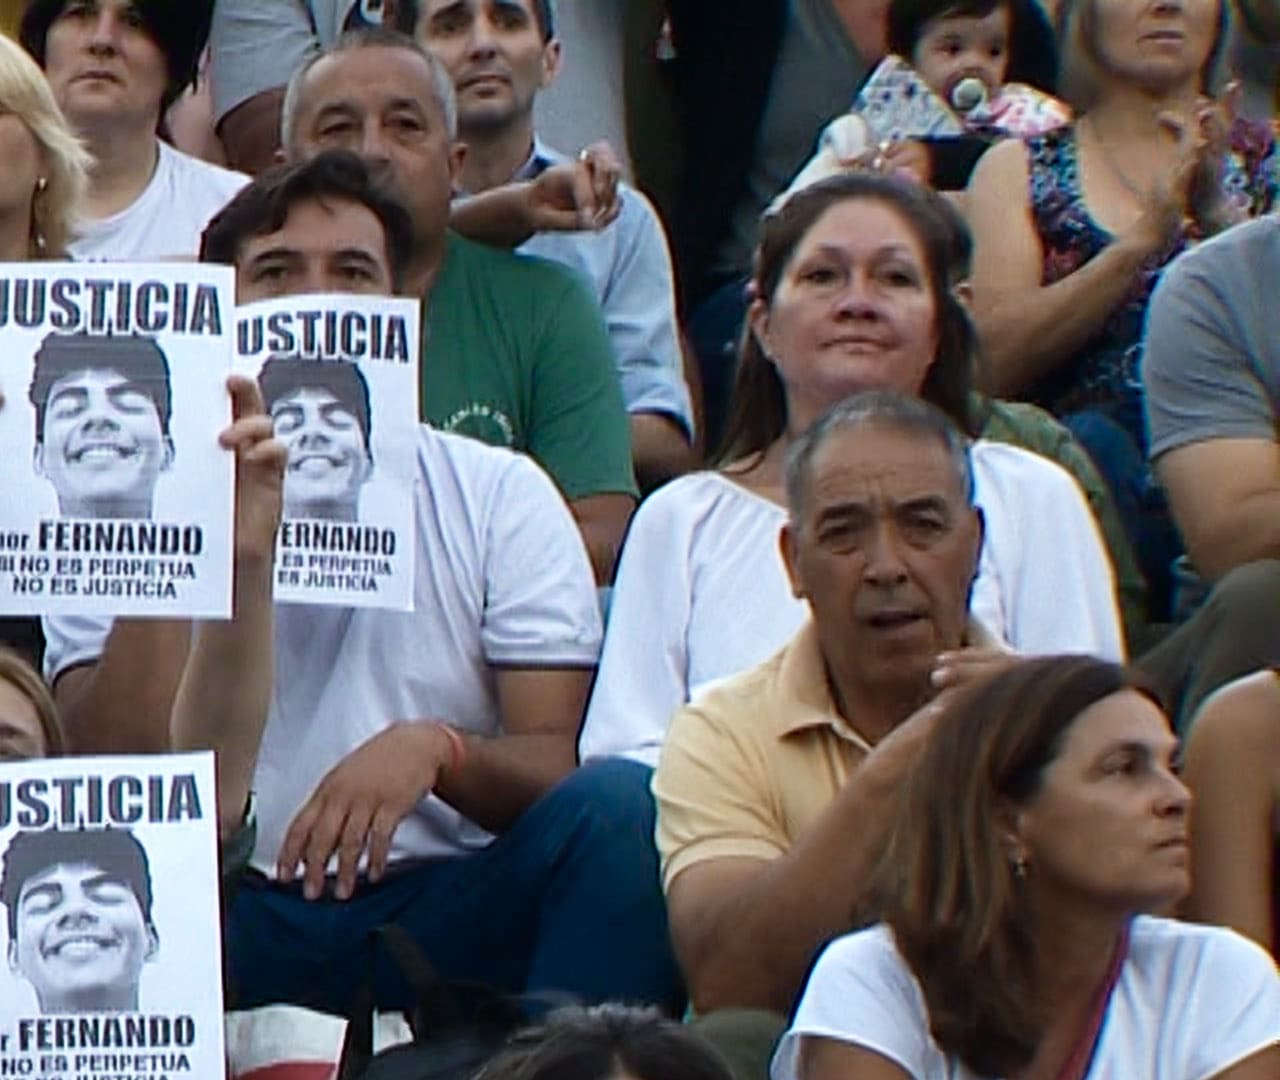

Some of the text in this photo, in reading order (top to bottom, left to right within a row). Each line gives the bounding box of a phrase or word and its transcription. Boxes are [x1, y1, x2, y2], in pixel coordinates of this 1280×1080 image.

[237, 310, 410, 363] USTICIA
[39, 521, 204, 556] FERNANDO
[281, 522, 397, 556] ERNANDO
[20, 557, 49, 574] NO
[57, 557, 83, 575] ES
[89, 558, 197, 580] PERPETUA
[308, 556, 392, 576] PERPETUA
[13, 577, 177, 599] NO ES JUSTICIA
[304, 572, 378, 592] JUSTICIA
[18, 1015, 196, 1051] FERNANDO
[1, 1057, 33, 1076] NO
[40, 1055, 69, 1072] ES
[75, 1054, 191, 1072] PERPETUA
